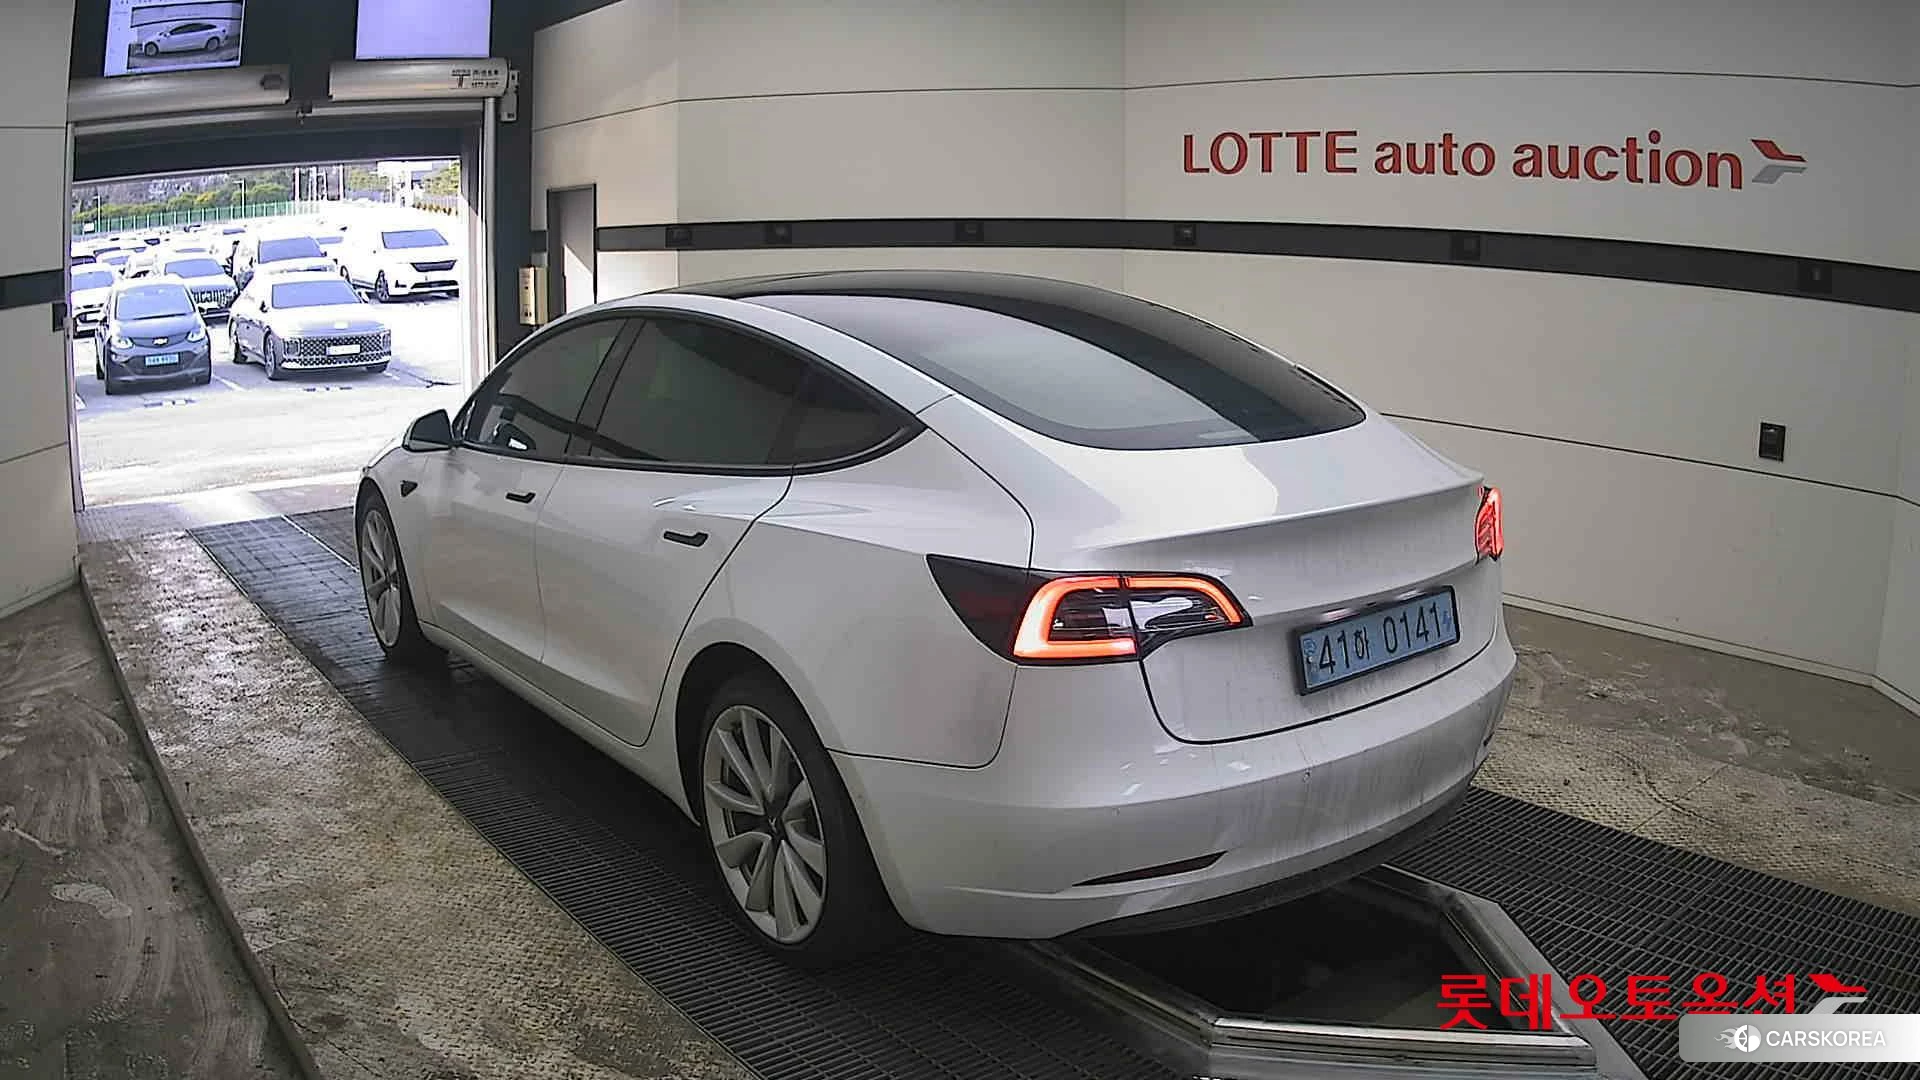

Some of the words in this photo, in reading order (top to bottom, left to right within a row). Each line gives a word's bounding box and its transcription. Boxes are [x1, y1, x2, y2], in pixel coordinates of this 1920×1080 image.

[1183, 130, 1358, 174] LOTTE
[1375, 132, 1495, 176] auto
[1513, 130, 1743, 189] auction
[1383, 602, 1441, 654] 0141
